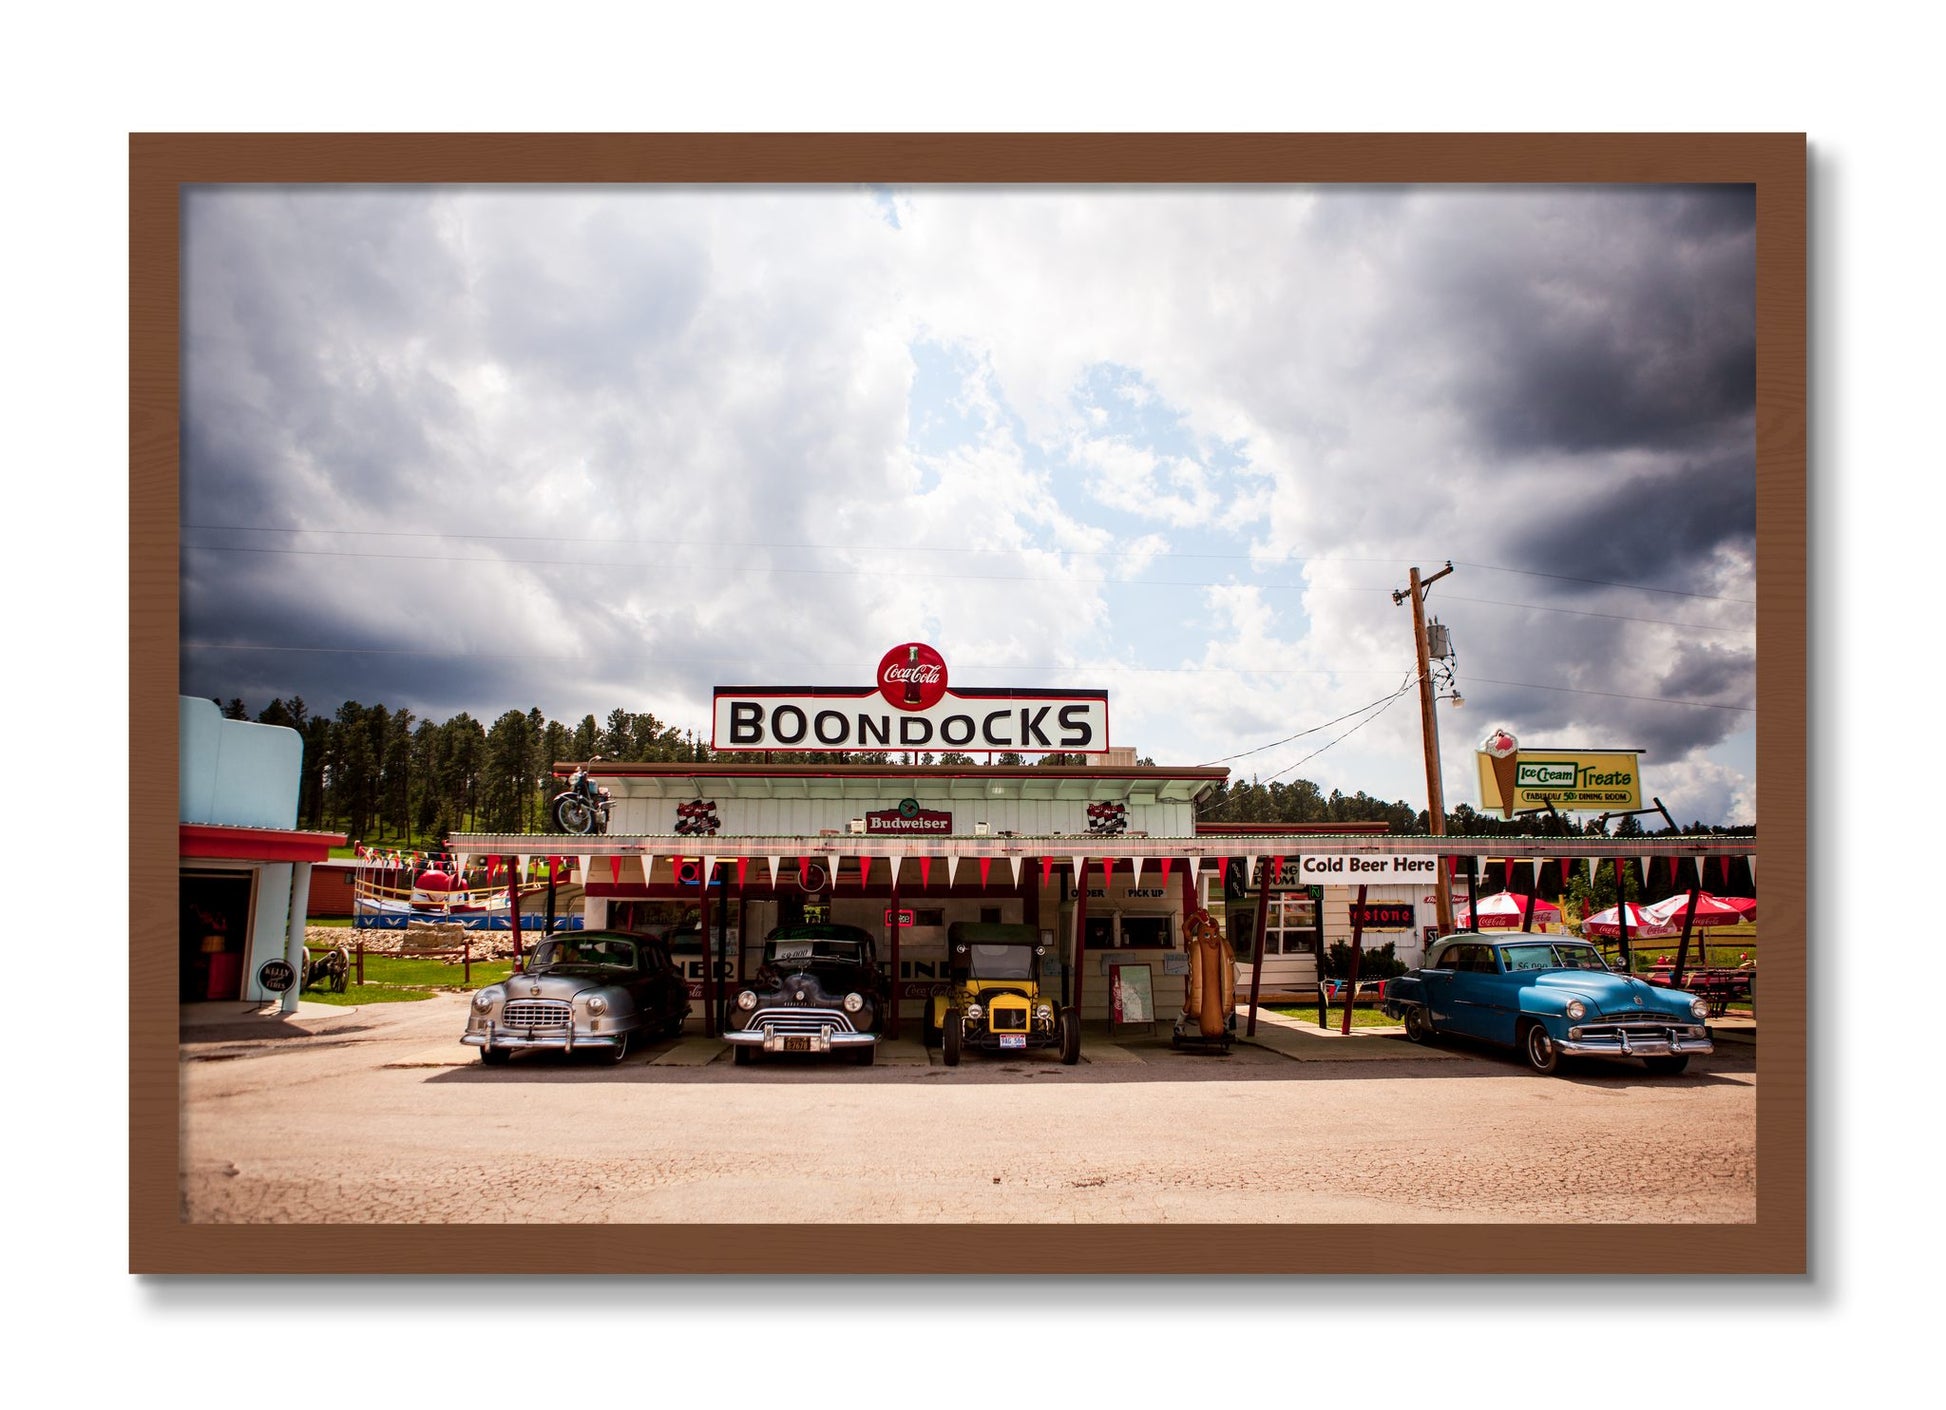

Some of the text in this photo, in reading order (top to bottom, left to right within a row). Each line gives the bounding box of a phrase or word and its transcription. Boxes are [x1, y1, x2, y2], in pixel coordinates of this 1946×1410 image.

[729, 701, 1092, 746] BOONDOCKS
[1537, 767, 1572, 782] Cream
[1578, 766, 1632, 788] Treats
[1579, 792, 1602, 800] DINING
[1605, 792, 1627, 800] ROOM
[870, 817, 948, 829] Budweiser
[1253, 865, 1298, 875] DINNG
[1303, 857, 1435, 872] Cold Beer Here
[1071, 889, 1105, 898] ODER
[1128, 889, 1164, 898] PICK UP
